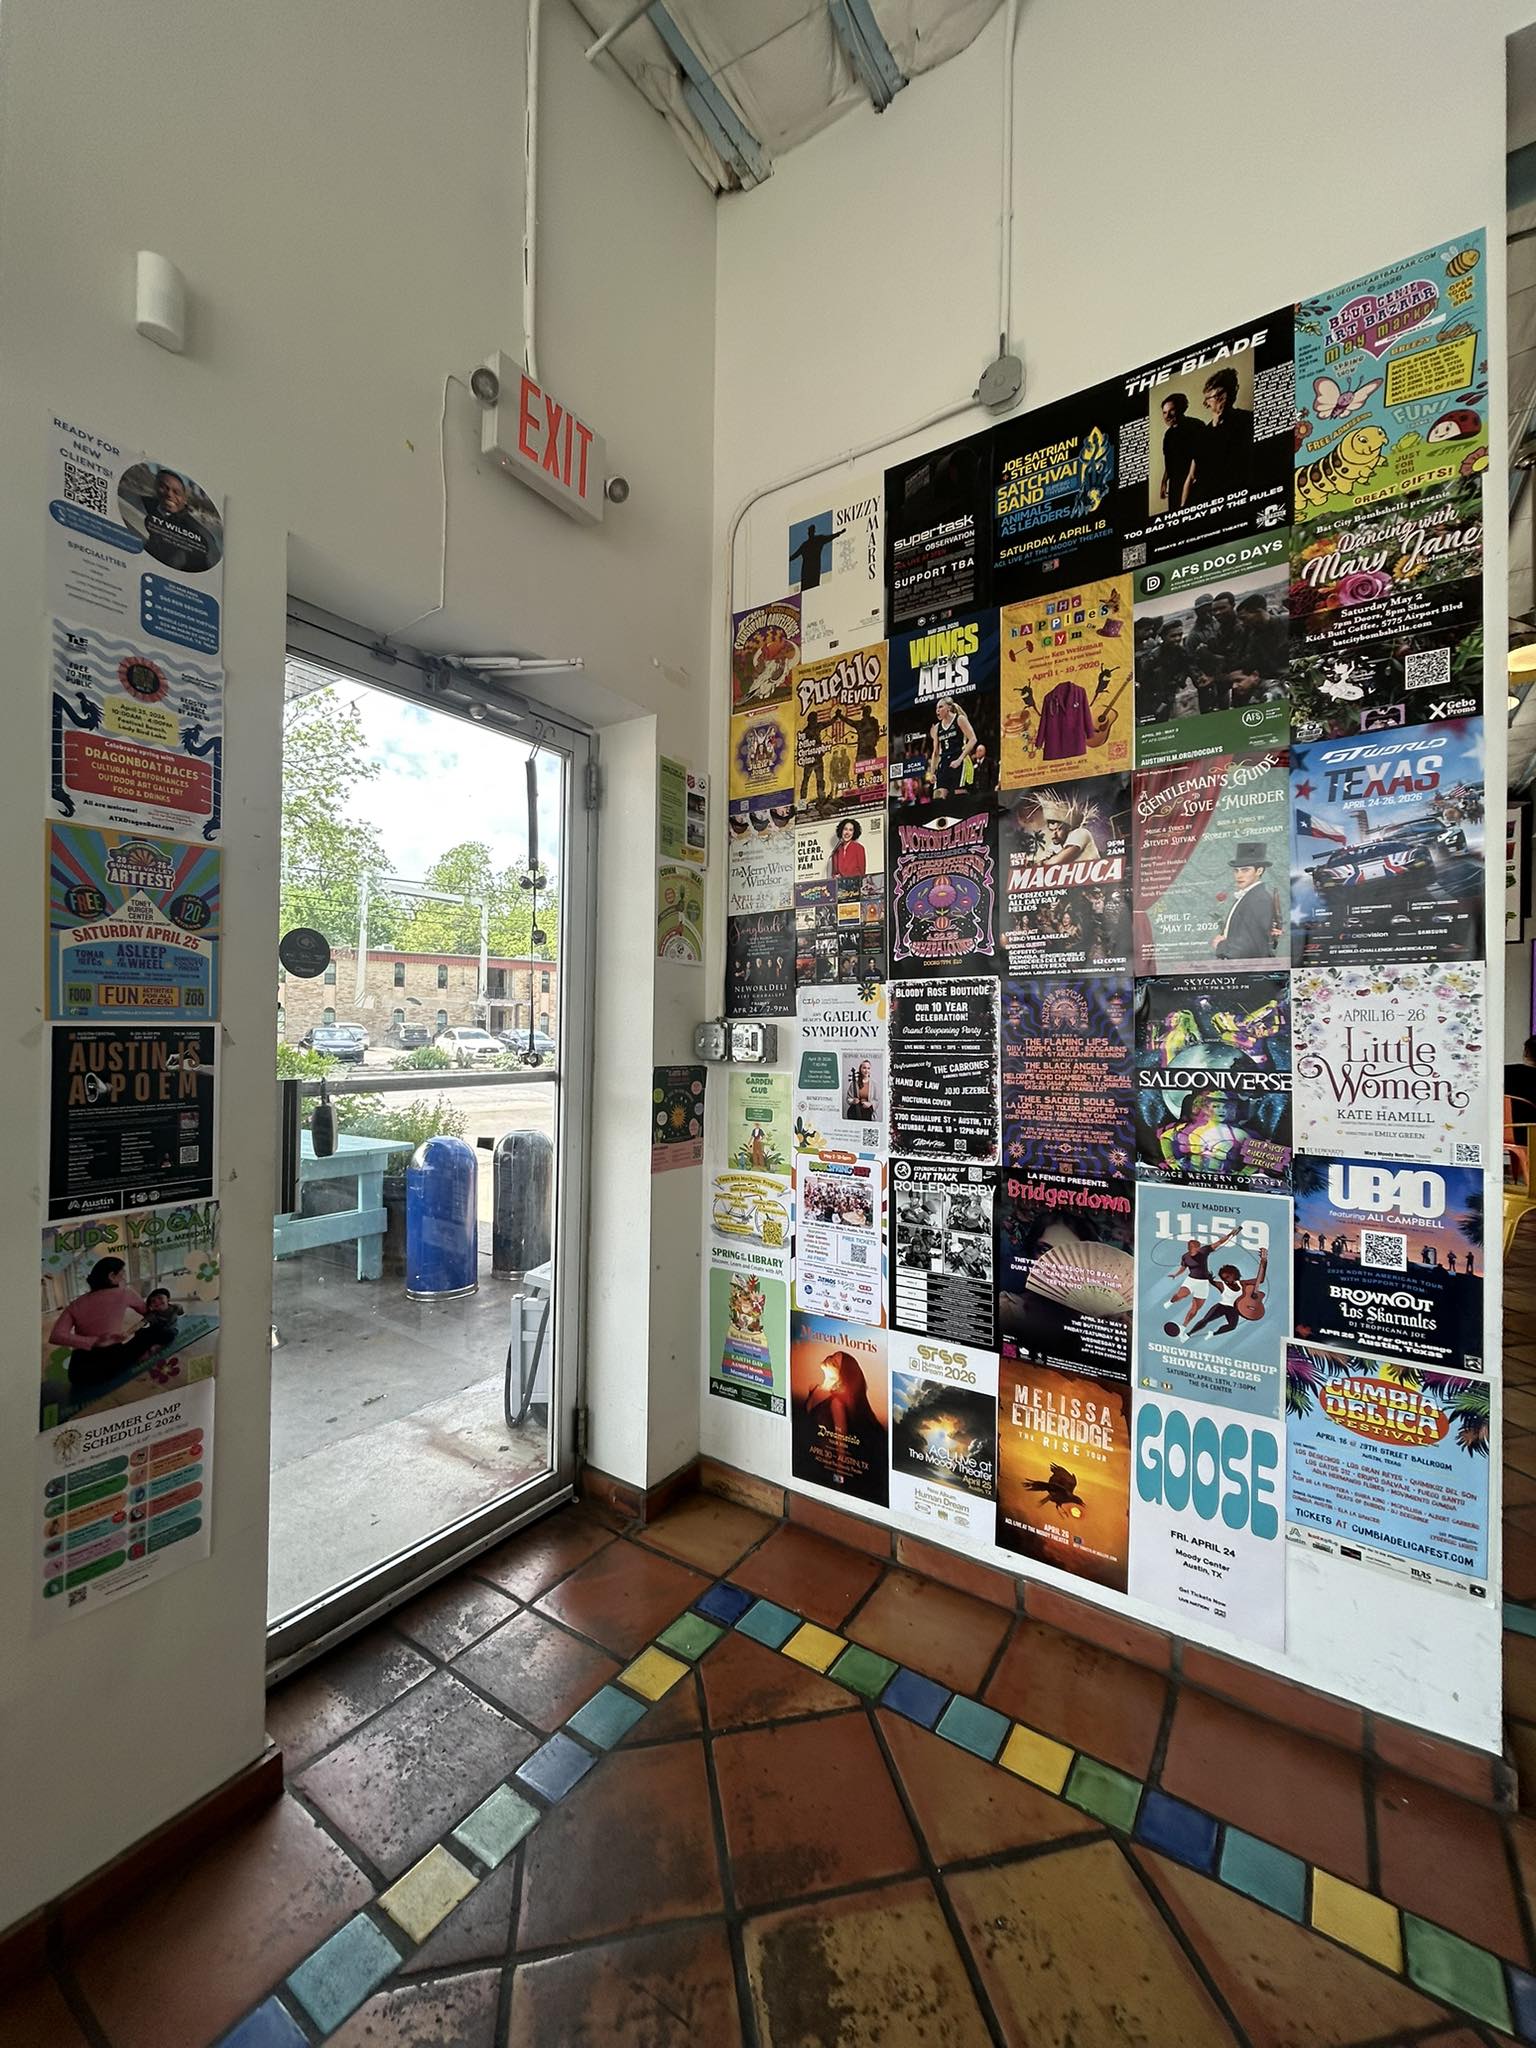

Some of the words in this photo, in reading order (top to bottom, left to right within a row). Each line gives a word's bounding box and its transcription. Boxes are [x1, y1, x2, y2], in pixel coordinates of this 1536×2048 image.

[1325, 323, 1358, 346] ART
[1365, 288, 1436, 327] BAZAAR
[1329, 301, 1372, 330] BLUE
[1377, 282, 1418, 306] GENIE
[1125, 368, 1171, 397] THE
[1180, 329, 1268, 376] BLADE
[54, 417, 94, 442] READY
[97, 439, 120, 456] FOR
[73, 440, 101, 460] NEW
[519, 374, 593, 498] EXIT
[60, 448, 113, 479] CLIENTS!
[1002, 458, 1023, 474] JOE
[1024, 436, 1078, 463] SATRIANI
[1010, 460, 1048, 480] STEVE
[1049, 451, 1069, 465] VAI
[997, 461, 1078, 499] SATCHVAI
[1354, 486, 1396, 505] GREAT
[1402, 467, 1454, 490] GIFTS!
[836, 496, 880, 526] SKIZZY
[997, 488, 1044, 515] BAND
[1001, 502, 1052, 527] ANIMALS
[1124, 530, 1143, 540] TOO
[1145, 522, 1164, 534] BAD
[1166, 518, 1180, 528] TO
[1182, 512, 1208, 525] PLAY
[1210, 505, 1224, 516] BY
[1226, 498, 1247, 509] THE
[1249, 486, 1284, 503] RULES
[1154, 516, 1163, 524] A
[1164, 495, 1225, 520] HARDBOILED
[1227, 489, 1248, 500] DUO
[1317, 525, 1332, 535] Bat
[1333, 520, 1352, 530] City
[1354, 503, 1408, 523] Bombshells
[1410, 492, 1449, 507] presents
[152, 515, 164, 530] TY
[165, 522, 201, 542] WILSON
[894, 514, 974, 548] supertask
[1001, 523, 1016, 537] AS
[1018, 506, 1070, 531] LEADERS
[1337, 520, 1418, 552] Dancing
[1420, 505, 1459, 531] with
[866, 515, 879, 580] MARS
[925, 530, 975, 551] OBSERVATION
[1000, 535, 1056, 559] SATURDAY,
[1059, 524, 1091, 541] APRIL
[1095, 519, 1106, 530] 18
[1171, 564, 1199, 581] AFS
[1203, 552, 1237, 571] DOC
[1240, 540, 1283, 561] DAYS
[1301, 552, 1387, 587] Mary
[1400, 526, 1483, 572] Jane
[894, 565, 947, 589] SUPPORT
[951, 558, 974, 571] TBA
[1341, 602, 1388, 618] Saturday
[1390, 596, 1413, 607] May
[910, 622, 979, 669] WINGS
[1333, 620, 1432, 647] batcitybombshells.com
[797, 652, 881, 716] Pueblo
[918, 655, 969, 697] ACES
[841, 684, 881, 704] REVOLT
[85, 747, 163, 772] DRAGONBOAT
[165, 766, 199, 781] RACES
[1141, 746, 1223, 767] AUSTINFILM.ORG/DOCDAYS
[1138, 774, 1229, 824] GENTLEMAN'S
[1228, 753, 1280, 789] GUIDE
[1324, 755, 1443, 803] TEXAS
[1180, 800, 1213, 817] LOVE
[1221, 790, 1285, 812] MURDER
[1343, 799, 1367, 810] APRIL
[1399, 793, 1422, 803] 2026
[110, 868, 173, 889] ARTFEST
[1008, 858, 1123, 891] MACHUCA
[72, 925, 144, 943] SATURDAY
[146, 925, 181, 945] APRIL
[185, 936, 200, 950] 25
[117, 944, 167, 958] ASLEEP
[105, 986, 138, 1004] FUN
[896, 986, 924, 998] BLOODY
[927, 986, 947, 996] ROSE
[950, 985, 989, 996] BOUTIQUE
[915, 1003, 929, 1011] OUR
[932, 1002, 941, 1012] 10
[945, 1002, 968, 1012] YEAR
[802, 1025, 879, 1038] SYMPHONY
[823, 1010, 872, 1022] GAELIC
[1343, 1010, 1380, 1022] APRIL
[1382, 1010, 1395, 1021] 16
[1409, 1010, 1426, 1021] 26
[68, 1041, 167, 1073] AUSTIN
[178, 1041, 201, 1069] IS
[1024, 1038, 1041, 1046] THE
[1044, 1038, 1083, 1046] FLAMING
[1086, 1038, 1108, 1046] LIPS
[1344, 1025, 1436, 1077] Little
[69, 1073, 86, 1105] A
[111, 1071, 197, 1103] POEM
[1298, 1053, 1470, 1108] Women
[1337, 1109, 1372, 1120] KATE
[1377, 1110, 1435, 1123] HAMILL
[914, 1172, 932, 1181] FLAT
[933, 1173, 958, 1182] TRACK
[1039, 1174, 1065, 1183] FENICE
[1067, 1177, 1109, 1188] PRESENTS:
[1328, 1164, 1446, 1219] UB40
[81, 1197, 114, 1209] Austin
[1007, 1178, 1130, 1213] Bridgerdown
[1202, 1204, 1241, 1214] MADDEN'S
[55, 1224, 119, 1253] KIDS
[128, 1209, 211, 1238] YOGA!
[1155, 1210, 1270, 1251] 11:59
[1368, 1213, 1384, 1222] ALI
[1387, 1215, 1444, 1229] CAMPBELL
[712, 1248, 740, 1260] SPRING
[748, 1254, 783, 1268] LIBRARY
[1330, 1286, 1434, 1313] BROWNOUT
[801, 1325, 836, 1345] Maren
[839, 1333, 877, 1354] Morris
[1148, 1343, 1233, 1366] SONGWRITING
[1234, 1360, 1277, 1375] GROUP
[1162, 1355, 1227, 1375] SHOWCASE
[1229, 1369, 1261, 1382] 2026
[944, 1367, 976, 1384] 2026
[1015, 1384, 1113, 1427] MELISSA
[1325, 1377, 1442, 1418] CUMBIA
[83, 1424, 152, 1453] SCHEDULE
[155, 1413, 181, 1428] 2026
[85, 1415, 142, 1441] SUMMER
[146, 1402, 181, 1420] CAMP
[1012, 1403, 1114, 1452] ETHERIDGE
[1326, 1397, 1439, 1439] DELICA
[1043, 1437, 1080, 1456] RISE
[1136, 1403, 1279, 1540] GOOSE
[1171, 1530, 1189, 1542] FRI.
[1191, 1537, 1220, 1552] APRIL
[1223, 1548, 1236, 1557] 24
[1296, 1508, 1332, 1525] TICKETS
[1335, 1519, 1347, 1529] AT
[1352, 1524, 1474, 1567] CUMBIADELICAFEST.COM
[1176, 1549, 1201, 1562] Moody
[1203, 1558, 1230, 1572] Center
